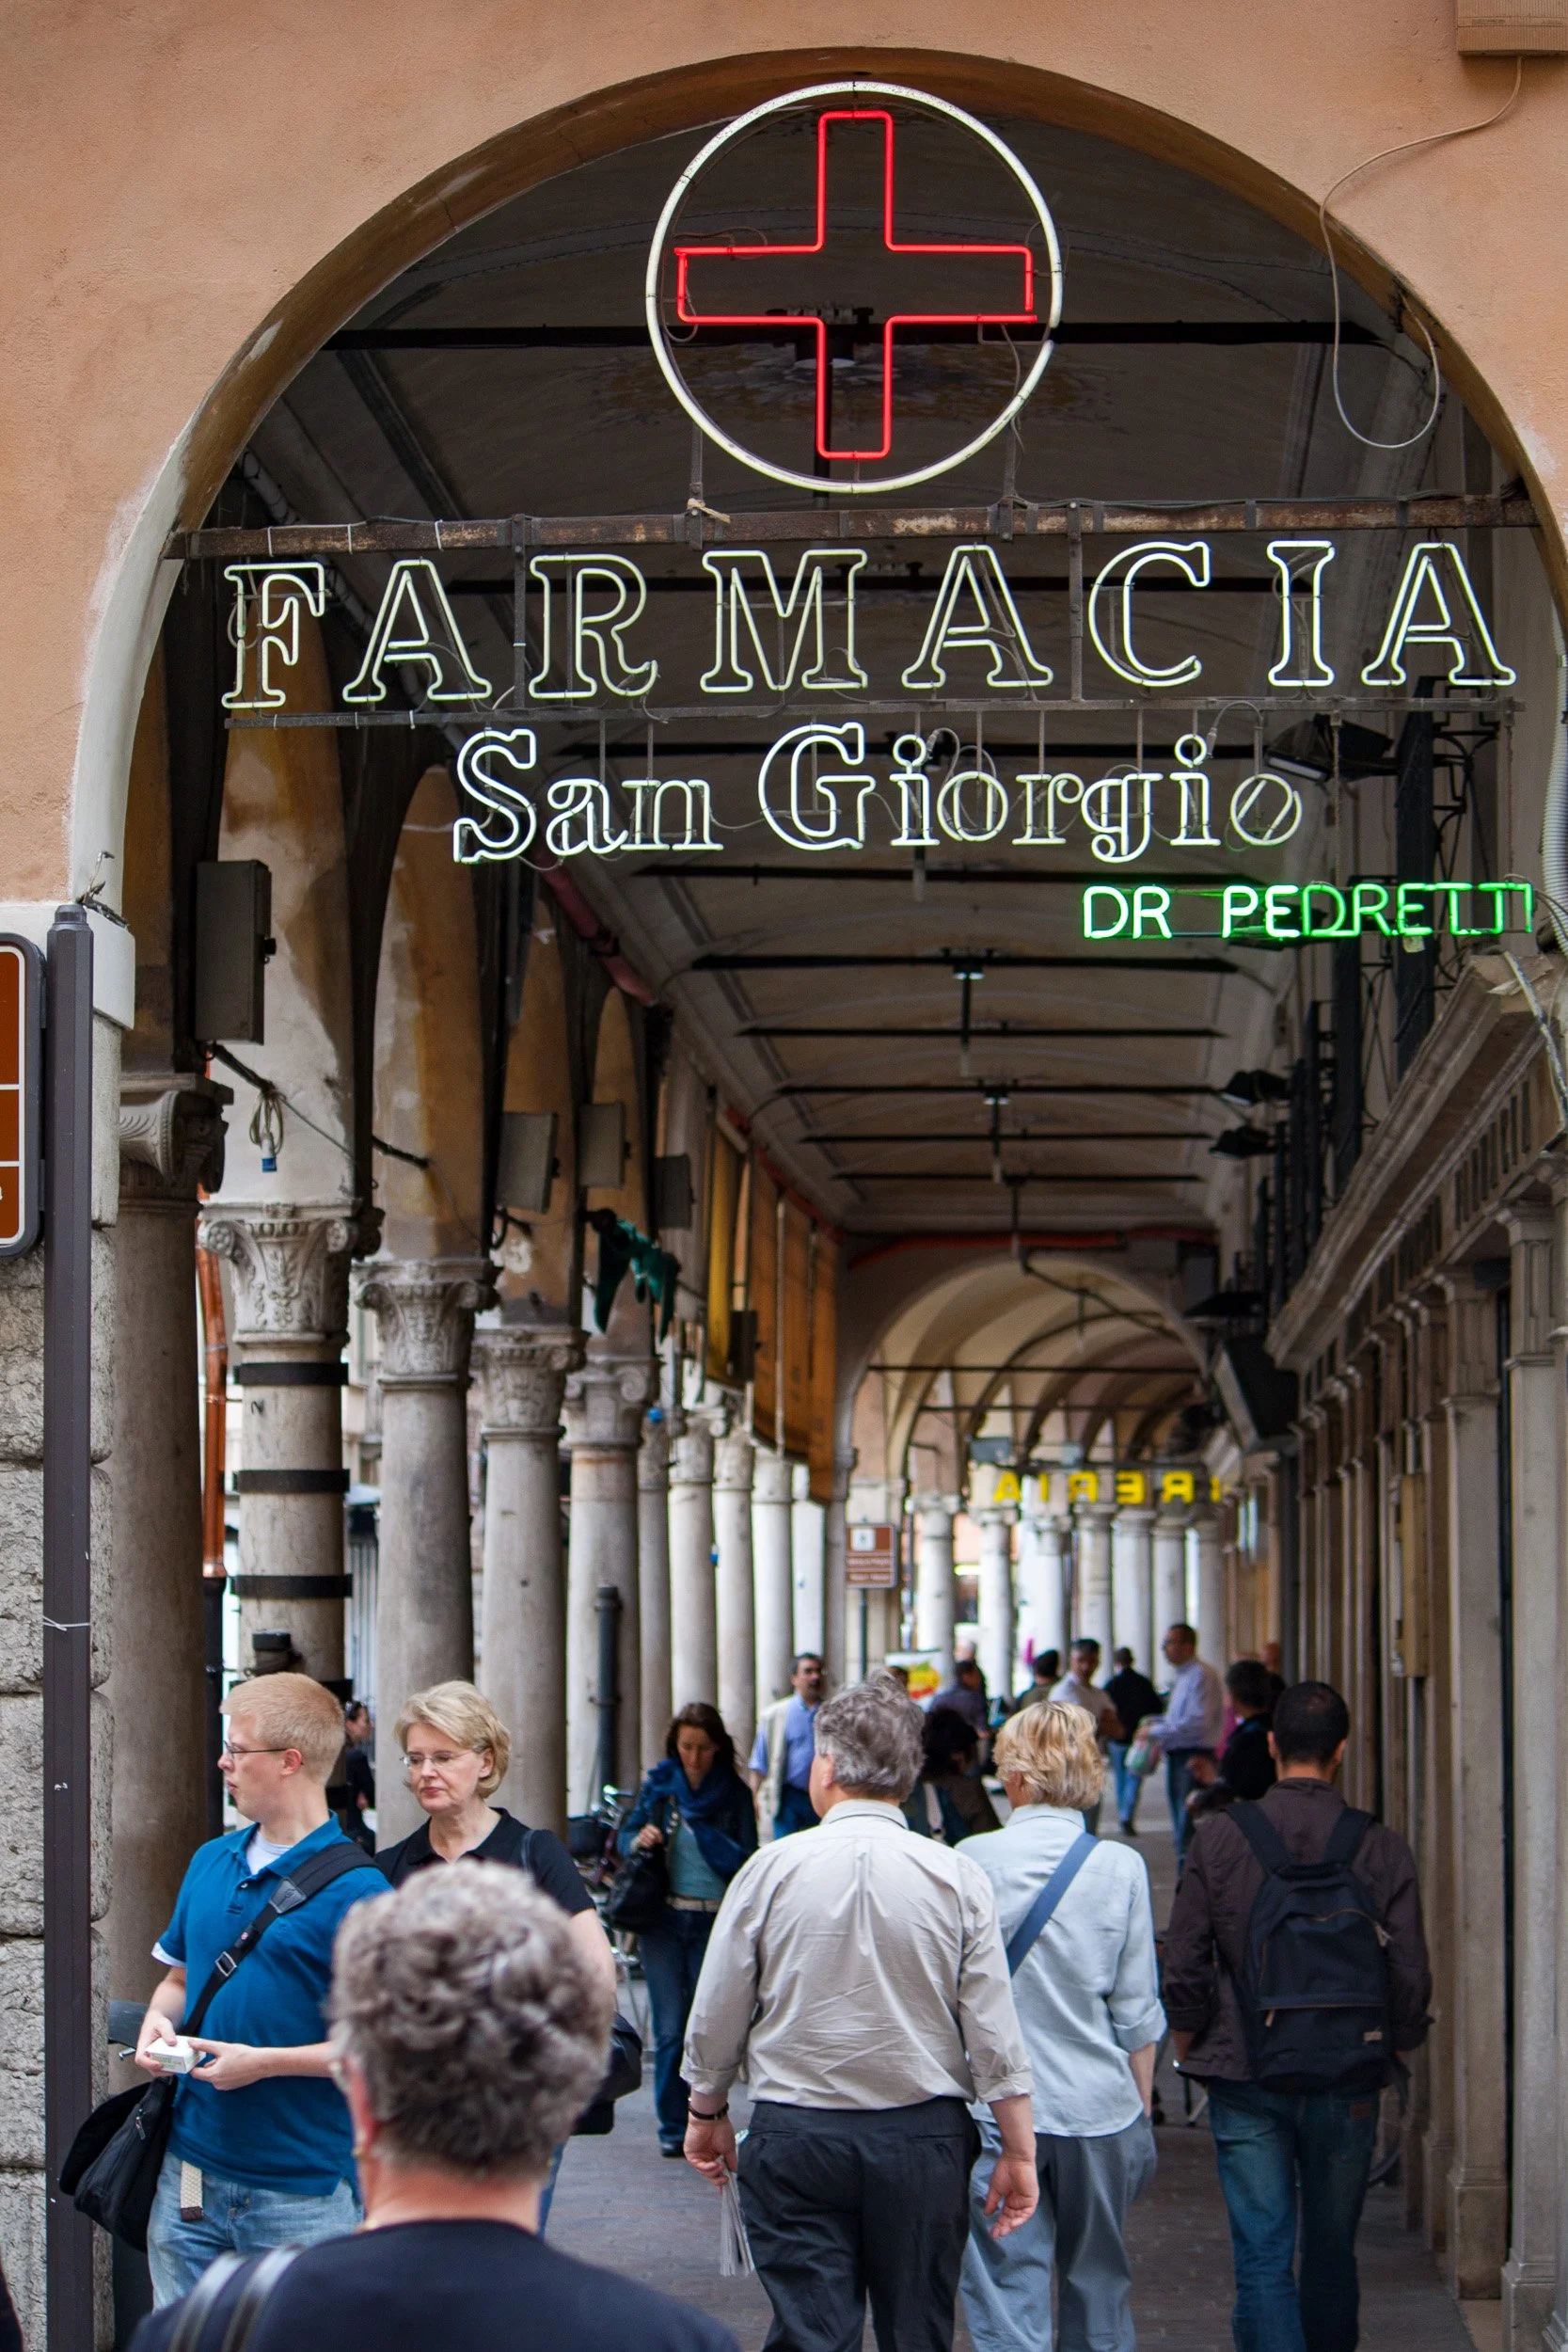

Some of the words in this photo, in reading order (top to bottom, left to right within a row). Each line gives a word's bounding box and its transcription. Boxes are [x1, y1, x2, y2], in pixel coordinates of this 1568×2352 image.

[221, 538, 1517, 710] FARMACIA
[452, 728, 723, 864] San
[757, 722, 1303, 864] Giorgio
[1082, 884, 1172, 940] DR
[1221, 882, 1534, 939] PEDRETTI
